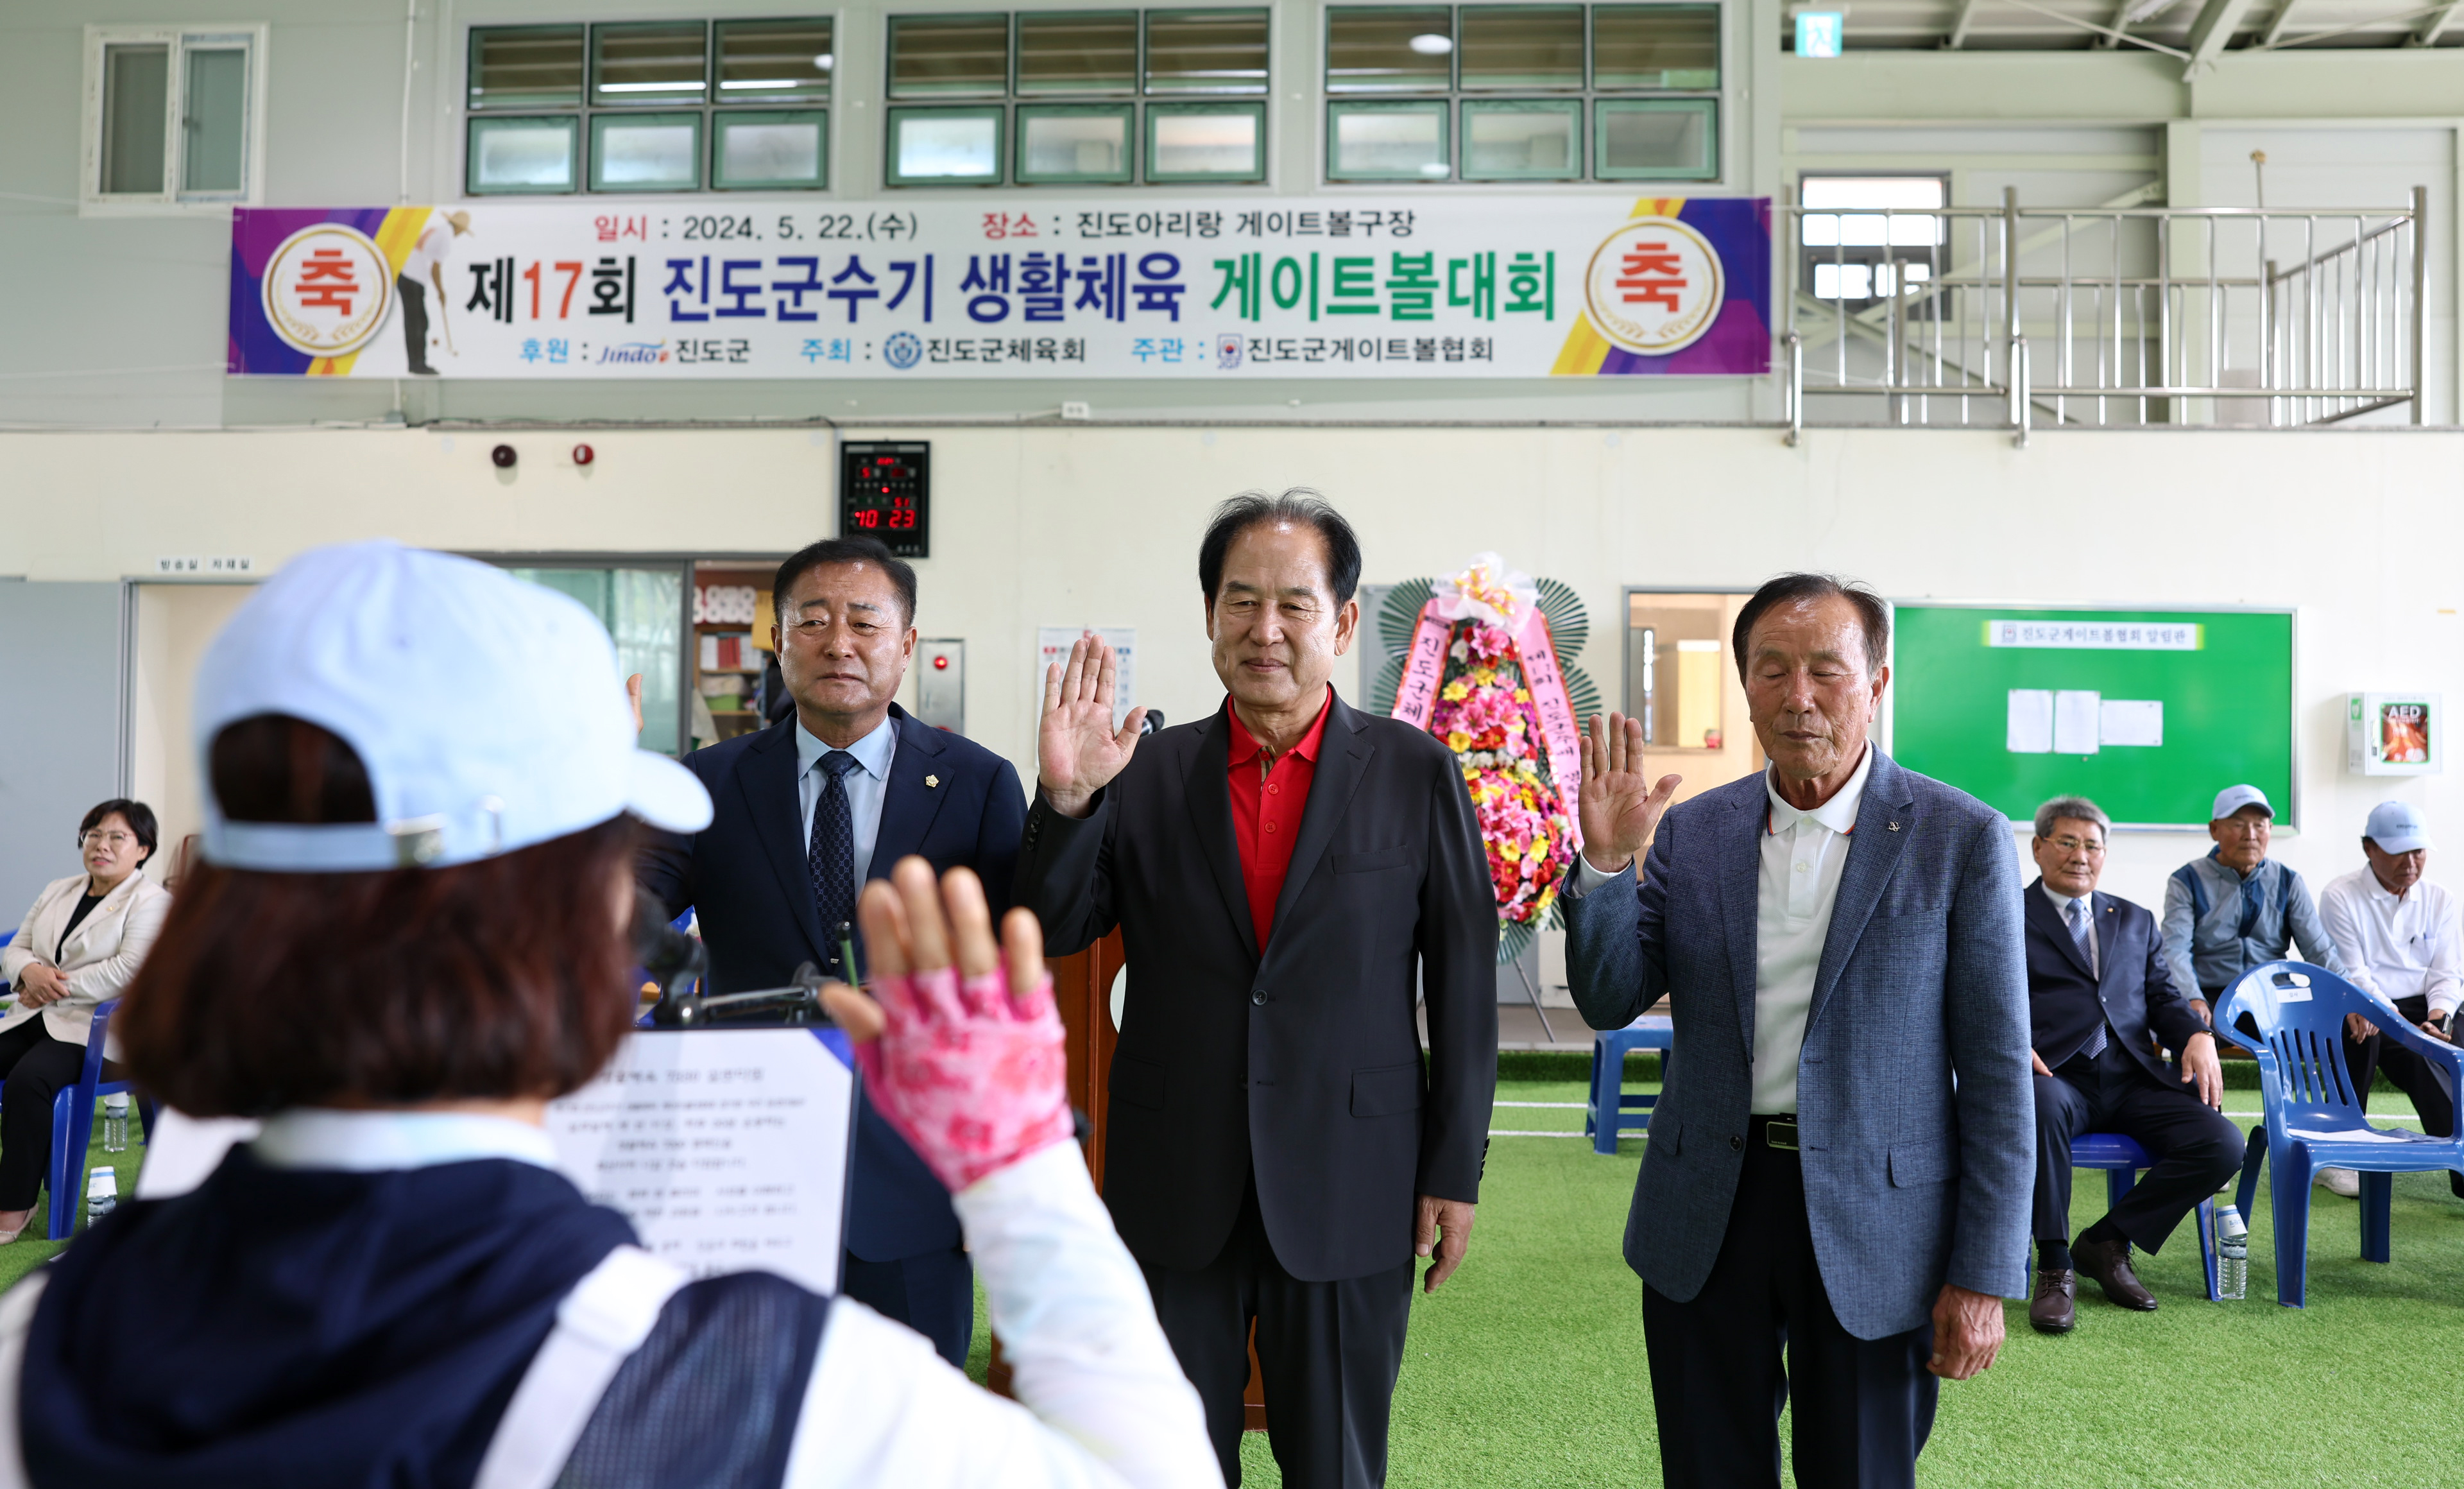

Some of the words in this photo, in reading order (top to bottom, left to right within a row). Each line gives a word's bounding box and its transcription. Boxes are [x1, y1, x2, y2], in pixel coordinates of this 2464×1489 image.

[594, 216, 647, 242] 일시
[683, 216, 762, 241] 2024.
[982, 212, 1038, 240] 장소
[1077, 211, 1223, 239] 진도아리랑
[1236, 210, 1415, 237] 게이트볼구장
[295, 248, 360, 317] 축
[466, 255, 636, 324] 제17회
[663, 253, 934, 323] 진도군수기
[959, 252, 1186, 324] 생활체육
[1210, 251, 1555, 322] 게이트볼대회
[1614, 242, 1688, 313] 축
[520, 338, 569, 363] 후원
[676, 339, 750, 363] 진도군
[801, 339, 851, 363] 주최
[927, 338, 1085, 363] 진도군체육회
[1132, 338, 1185, 363] 주관
[1248, 337, 1493, 363] 진도군게이트볼협회
[889, 509, 916, 528] 23
[2388, 705, 2422, 718] AED
